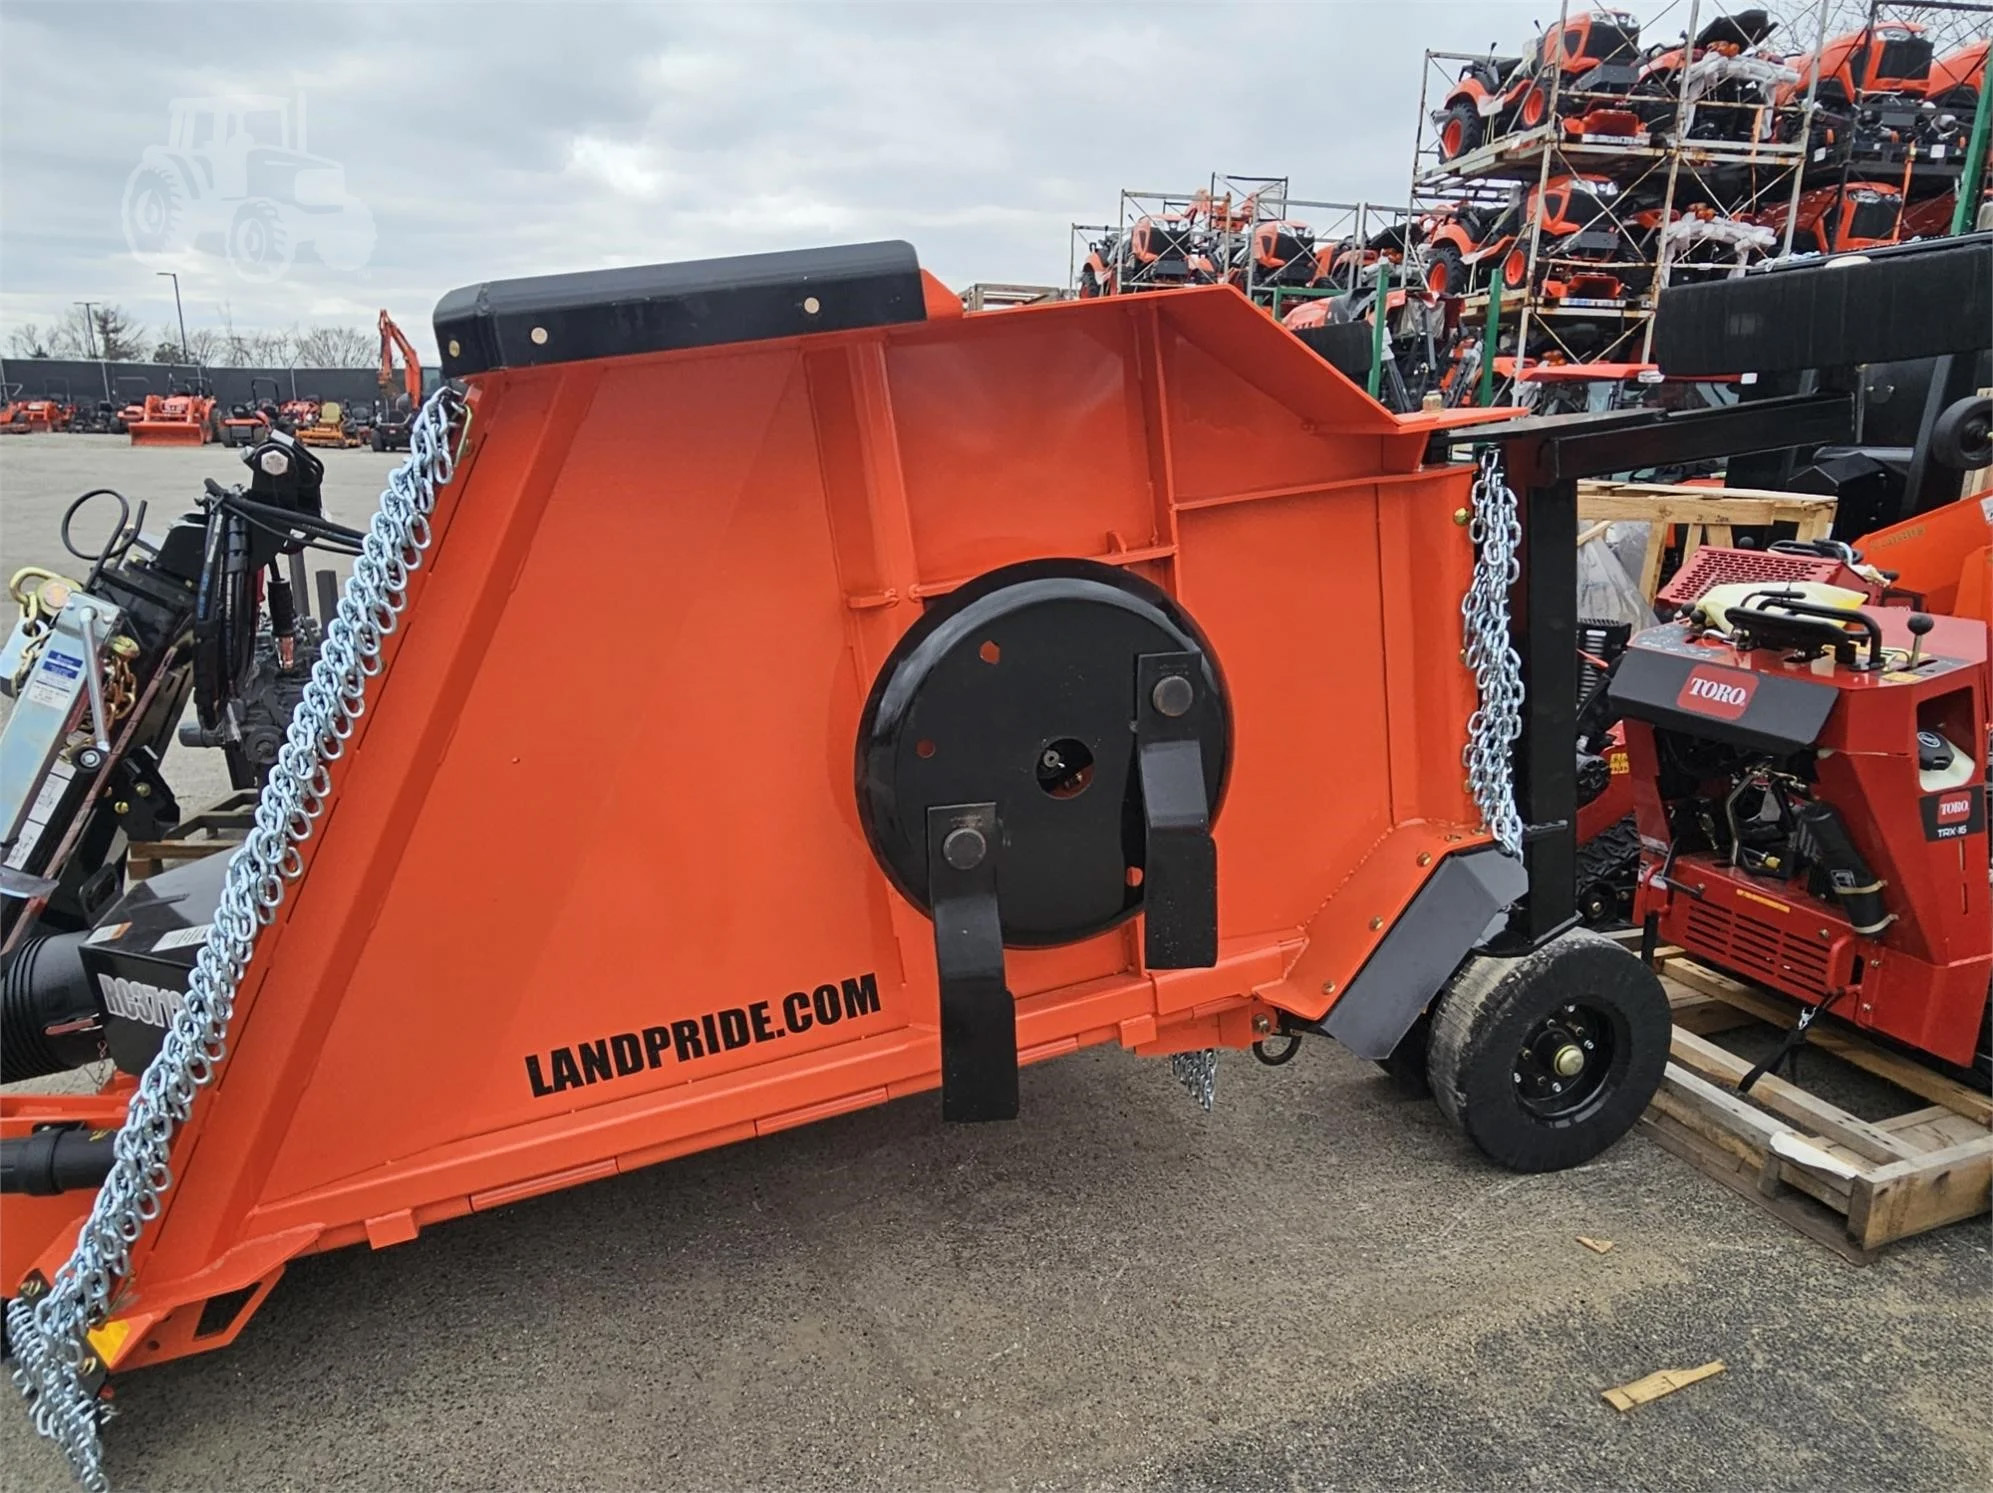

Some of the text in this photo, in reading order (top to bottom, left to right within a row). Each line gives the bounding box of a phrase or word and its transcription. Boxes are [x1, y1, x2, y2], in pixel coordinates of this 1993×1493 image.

[1689, 677, 1746, 705] TORO
[1940, 800, 1969, 815] TORO
[525, 973, 881, 1098] LANDPRIDE.COM
